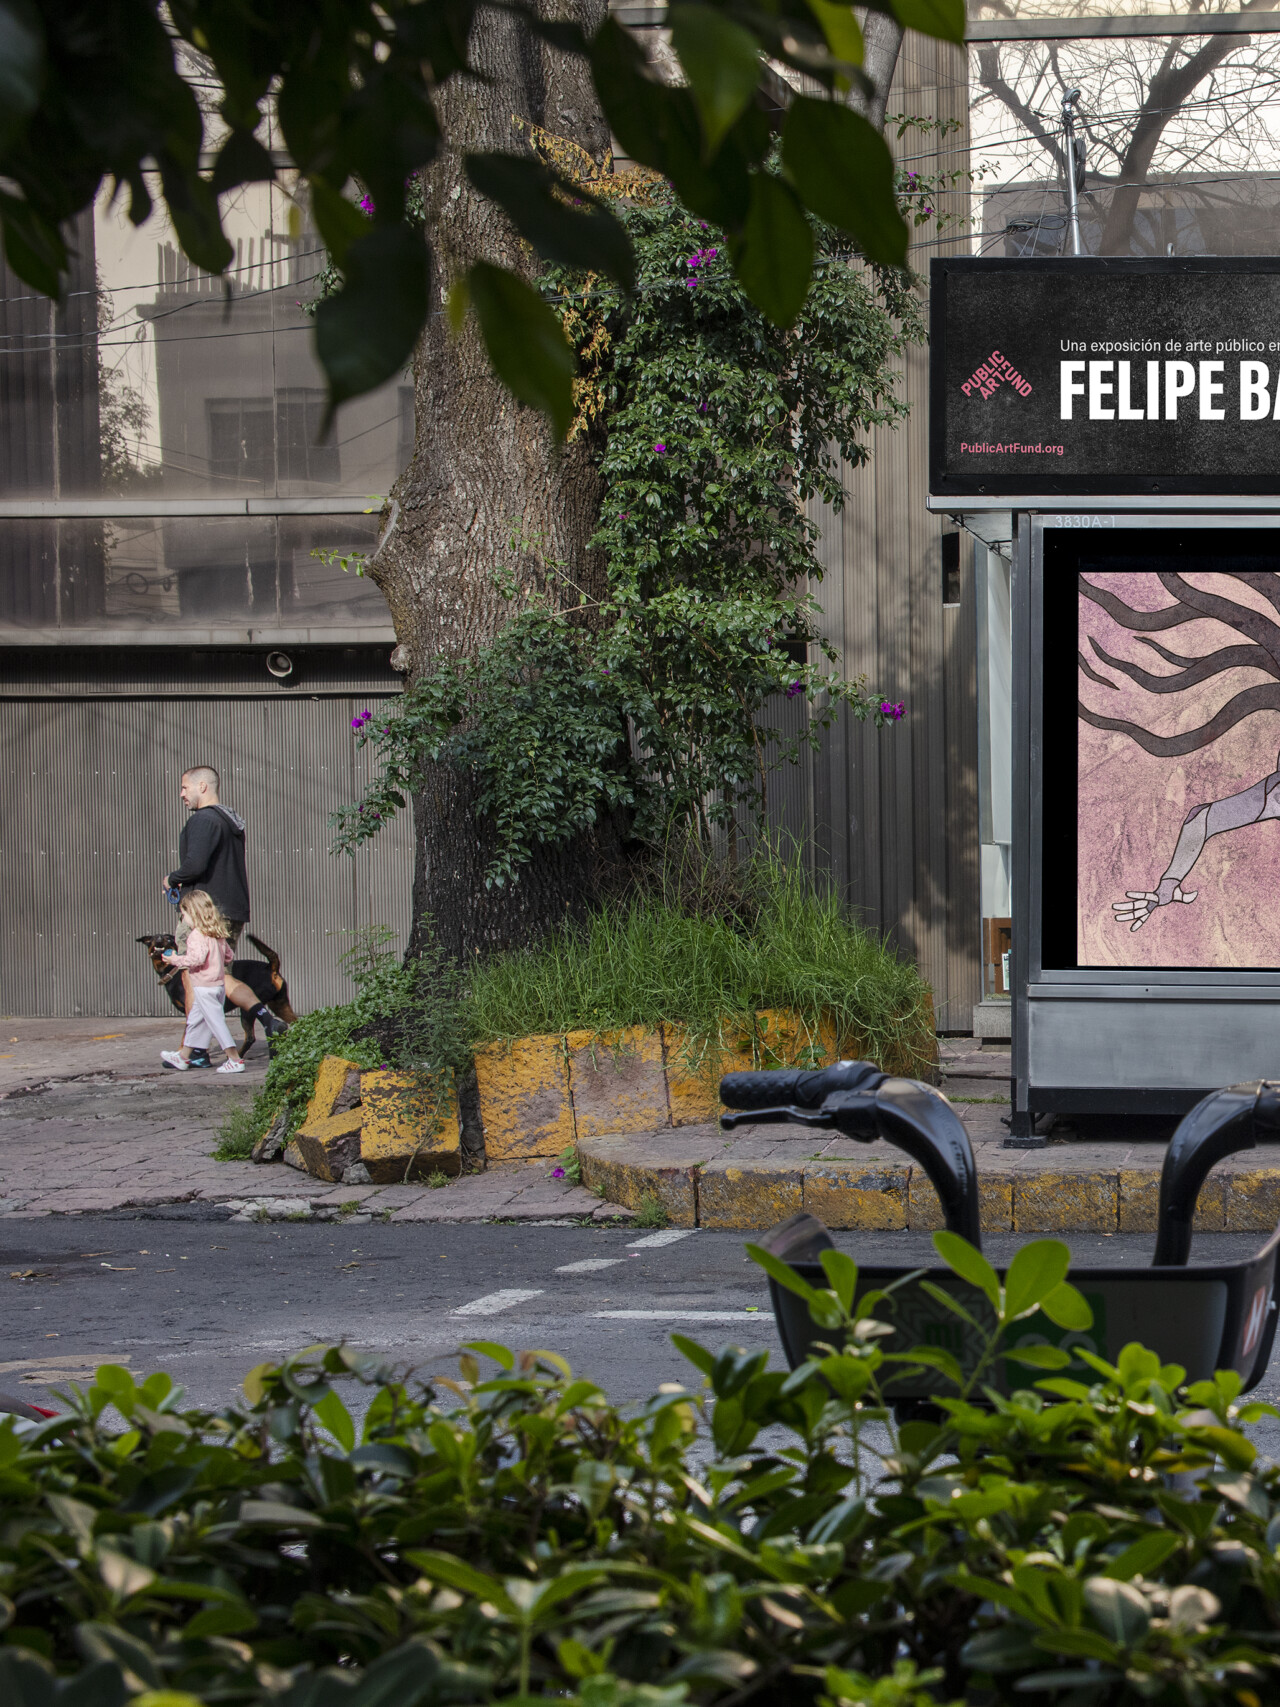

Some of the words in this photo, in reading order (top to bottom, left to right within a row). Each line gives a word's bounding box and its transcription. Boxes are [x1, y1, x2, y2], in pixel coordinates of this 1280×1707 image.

[1060, 339, 1087, 352] Una
[1090, 338, 1162, 354] exposición
[1165, 339, 1182, 352] de
[1185, 339, 1212, 352] arte
[1216, 338, 1265, 354] público
[960, 350, 1005, 397] PUBLIC
[979, 369, 1006, 400] ART
[998, 360, 1033, 397] FUND
[1060, 360, 1225, 420] FELIPE
[960, 442, 1064, 456] PublicArtFund.org
